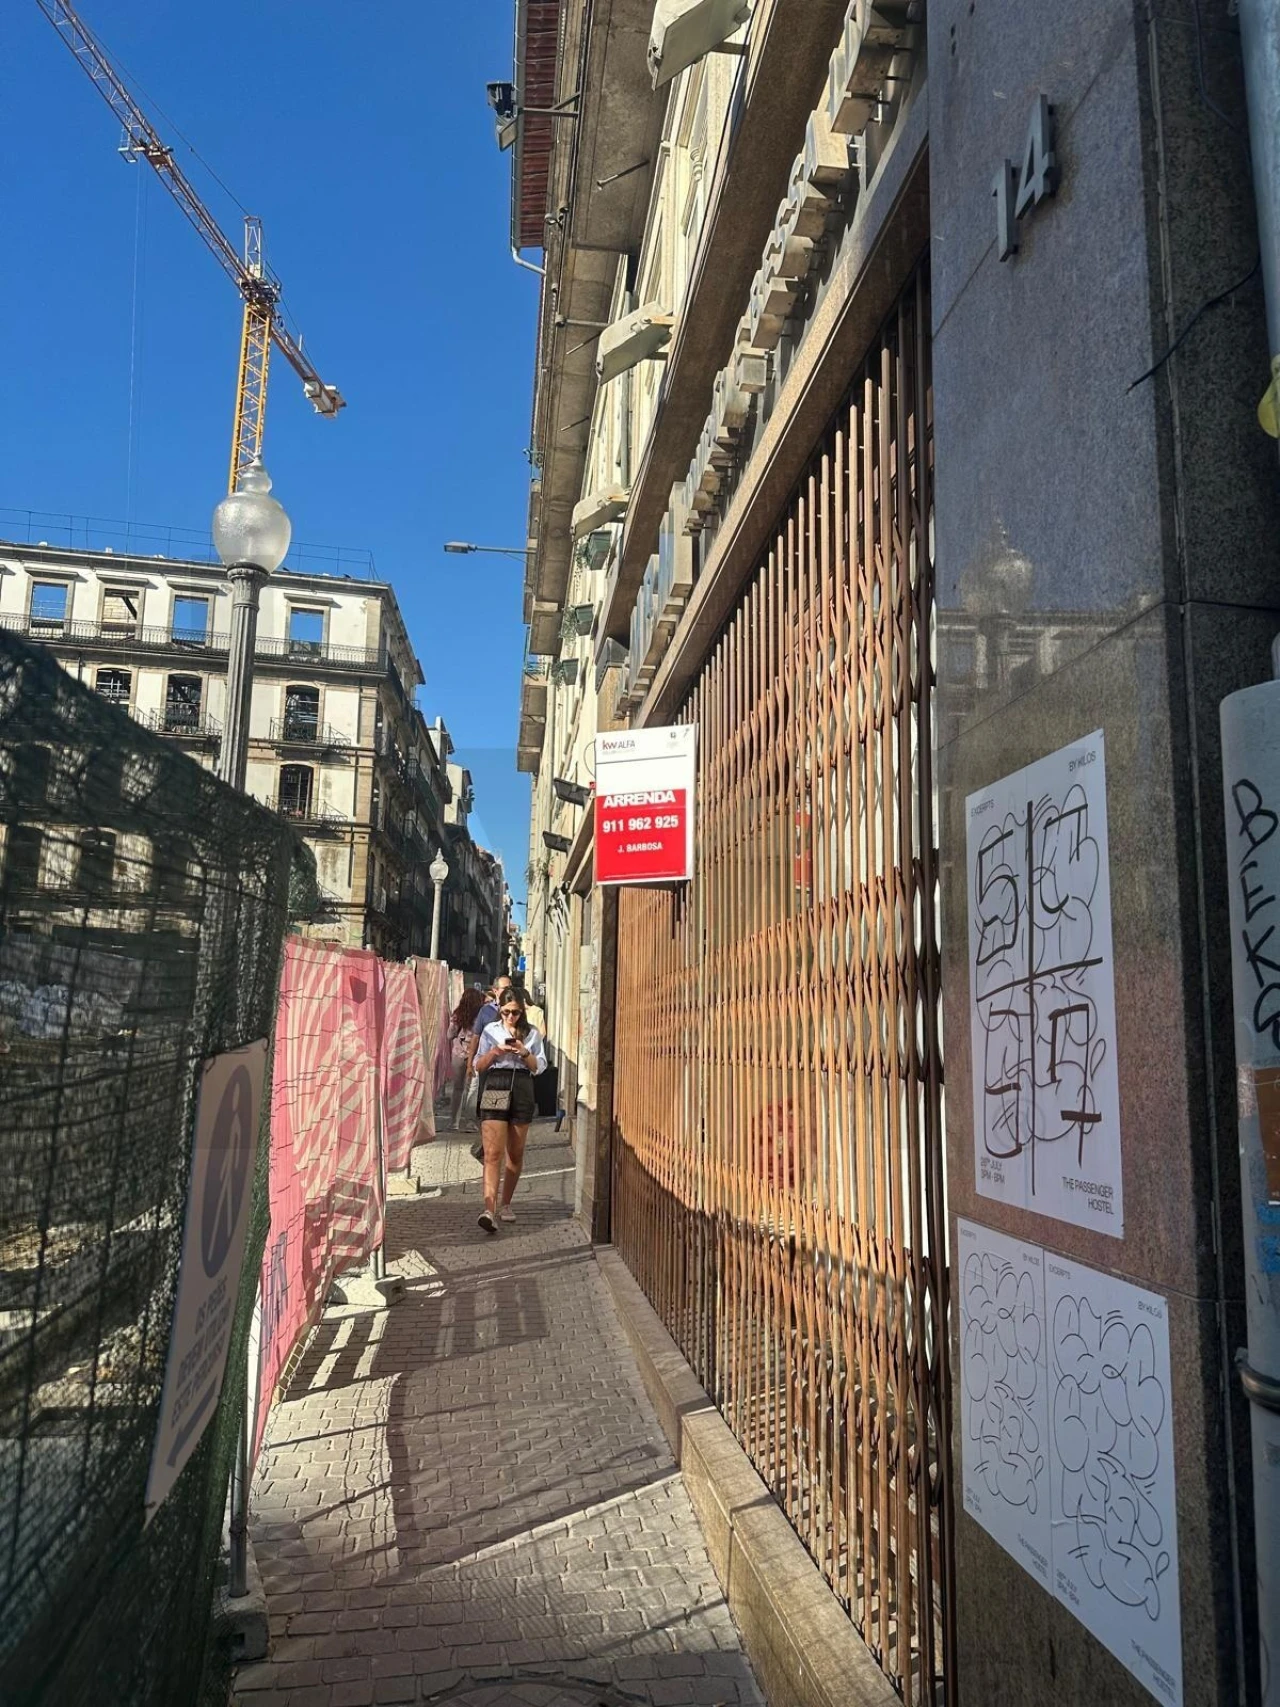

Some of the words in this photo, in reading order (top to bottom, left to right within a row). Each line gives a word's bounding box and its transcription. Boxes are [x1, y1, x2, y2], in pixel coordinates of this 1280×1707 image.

[992, 94, 1056, 262] 14
[618, 739, 636, 749] ALFA
[603, 790, 676, 809] ARRENDA
[603, 819, 624, 833] 911
[628, 817, 651, 831] 962
[655, 815, 678, 829] 925
[626, 841, 663, 853] BARBOSA
[1062, 1176, 1074, 1190] THE
[1075, 1179, 1113, 1199] PASSENGER
[1088, 1198, 1114, 1215] HOSTEL
